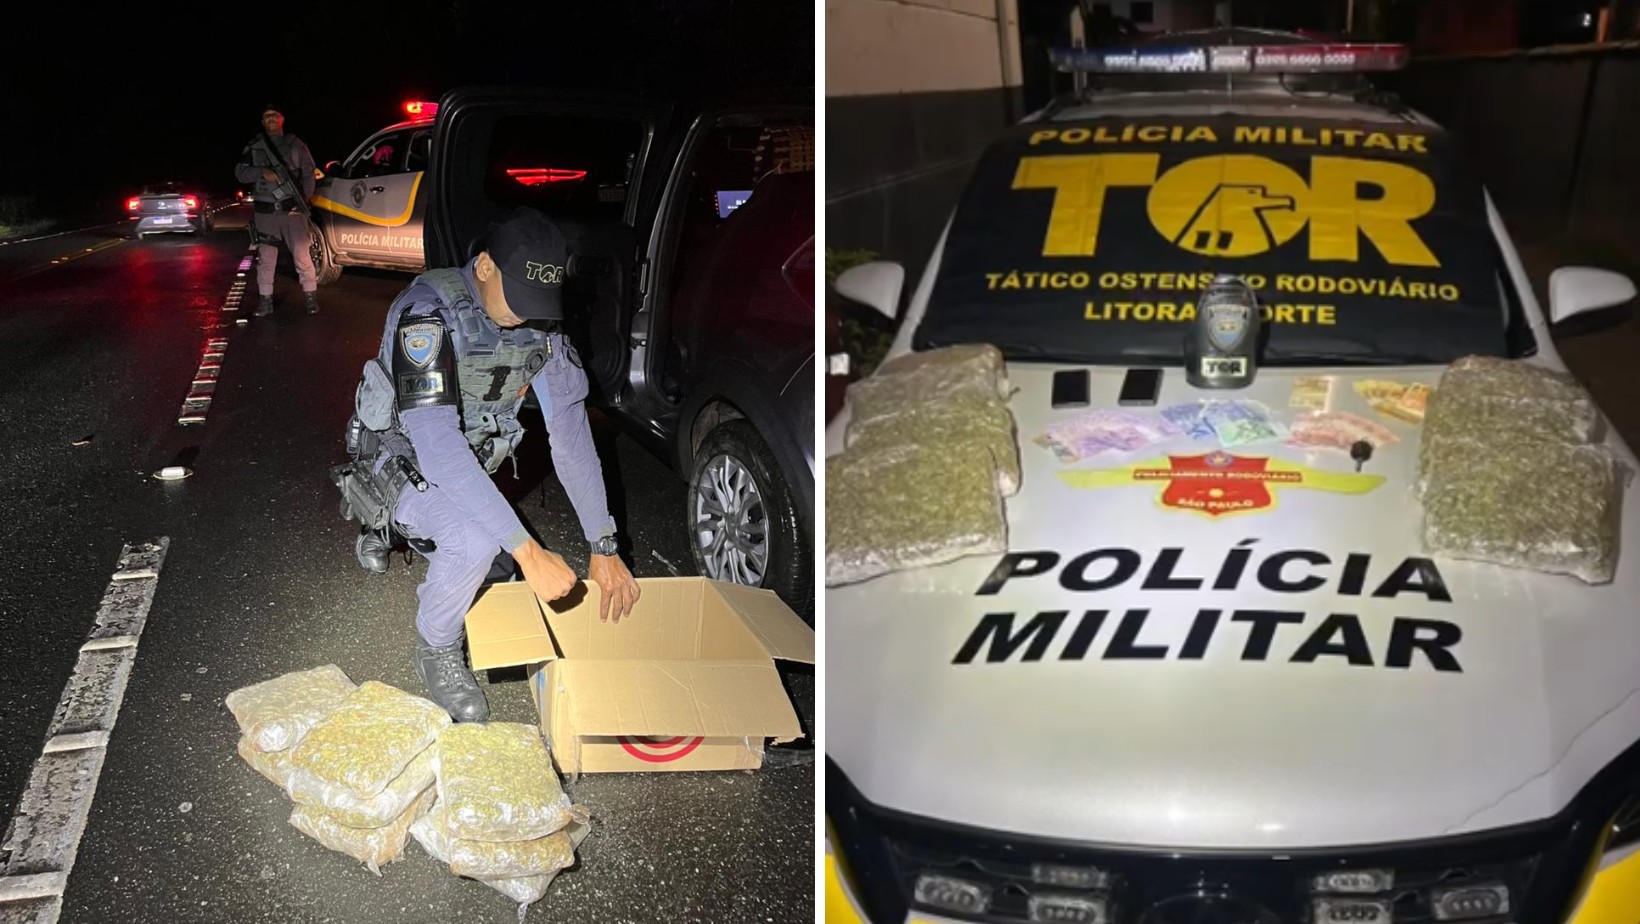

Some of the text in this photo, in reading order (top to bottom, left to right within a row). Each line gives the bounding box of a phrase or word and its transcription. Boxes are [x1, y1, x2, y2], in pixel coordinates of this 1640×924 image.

[1029, 124, 1427, 152] POLÍCIA MILITAR
[1012, 153, 1441, 267] TOR
[341, 232, 424, 249] POLÍCIA MILITAR
[986, 270, 1459, 300] TÁTICO OSTENSO RODOVIÁRIO
[1084, 302, 1336, 325] LITORA ORTE
[1206, 360, 1242, 374] TOR
[975, 538, 1453, 602] POLÍCIA
[951, 609, 1464, 672] MILITAR
